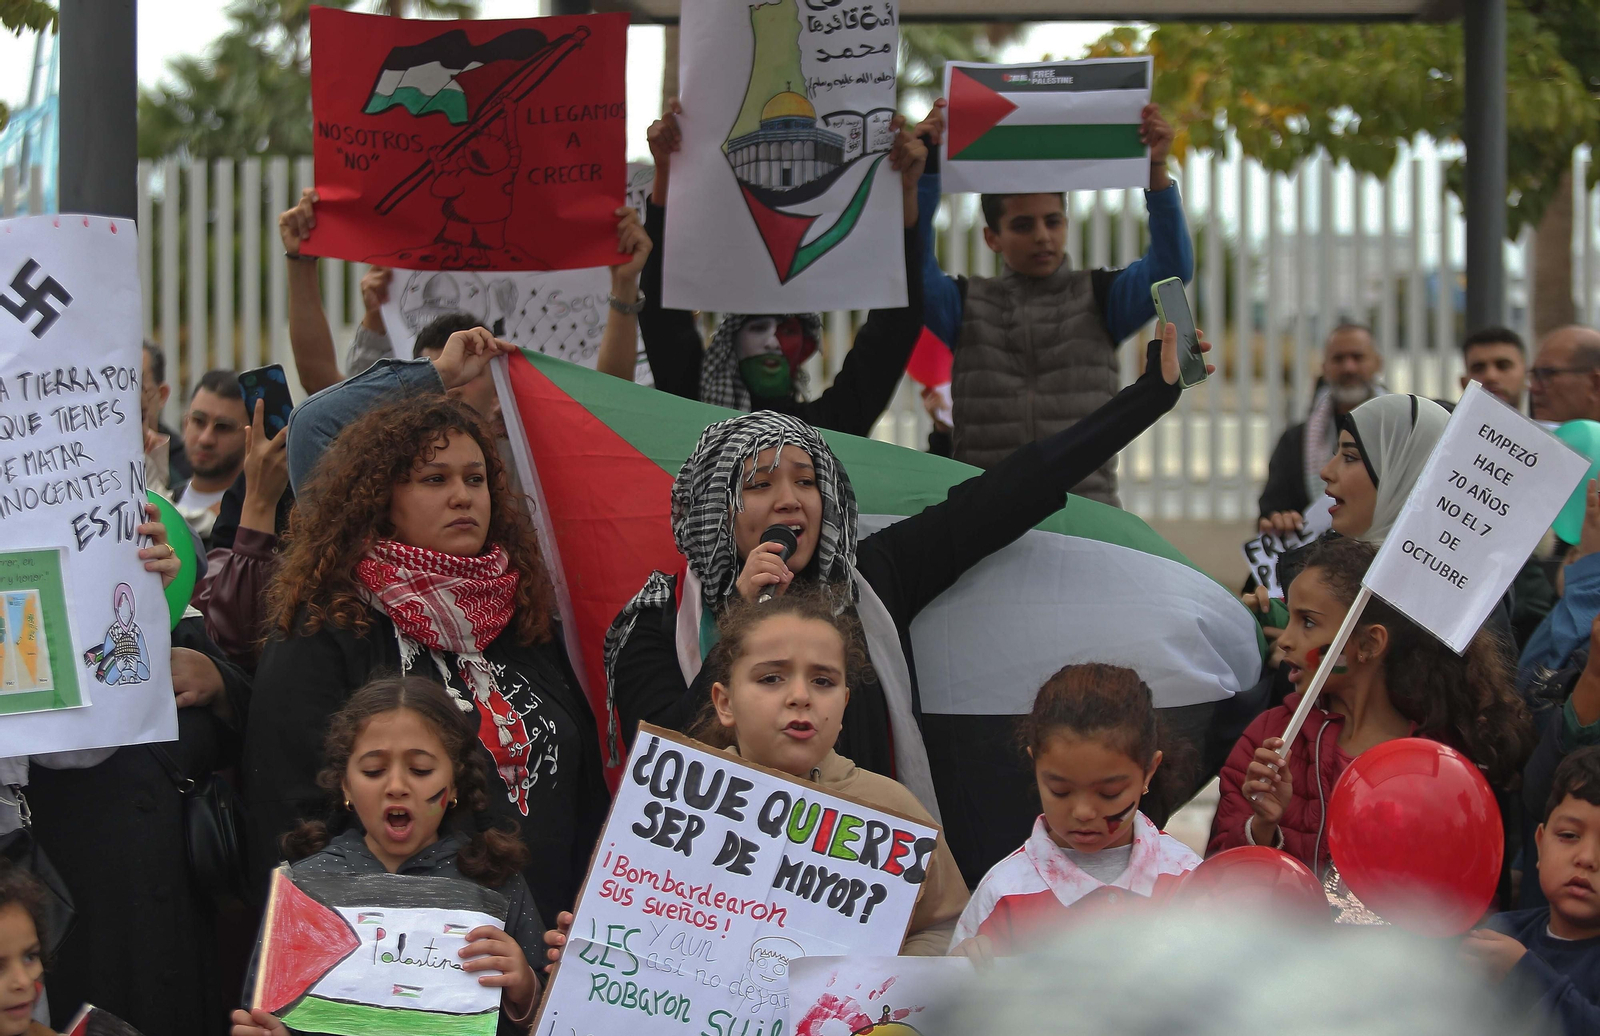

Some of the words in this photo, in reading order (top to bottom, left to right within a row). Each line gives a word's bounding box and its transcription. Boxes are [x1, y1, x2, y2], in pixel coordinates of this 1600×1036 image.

[816, 43, 891, 63] محمد
[1031, 76, 1074, 85] PALESTINE
[1032, 69, 1056, 79] FREE
[318, 120, 424, 153] NOSOTROS
[565, 131, 582, 150] A
[527, 163, 603, 186] CRECER
[17, 366, 101, 402] TIERRA
[101, 365, 139, 391] POR
[51, 398, 126, 435] TIENES
[24, 441, 95, 476] MATAR
[1478, 423, 1540, 468] EMPEZÓ
[1473, 453, 1514, 486] HACE
[1448, 470, 1468, 490] 70
[1466, 482, 1511, 518] AÑOS
[1436, 496, 1460, 519] NO
[1461, 512, 1479, 532] EL
[1481, 523, 1493, 538] 7
[1438, 530, 1461, 552] DE
[1401, 539, 1469, 590] OCTUBRE
[632, 736, 755, 823] ¿QUE
[757, 789, 938, 884] QUIERES
[631, 800, 706, 857] SER
[712, 830, 761, 877] DE
[772, 854, 888, 925] MAYOR?
[578, 917, 642, 977] LES
[695, 968, 722, 989] no
